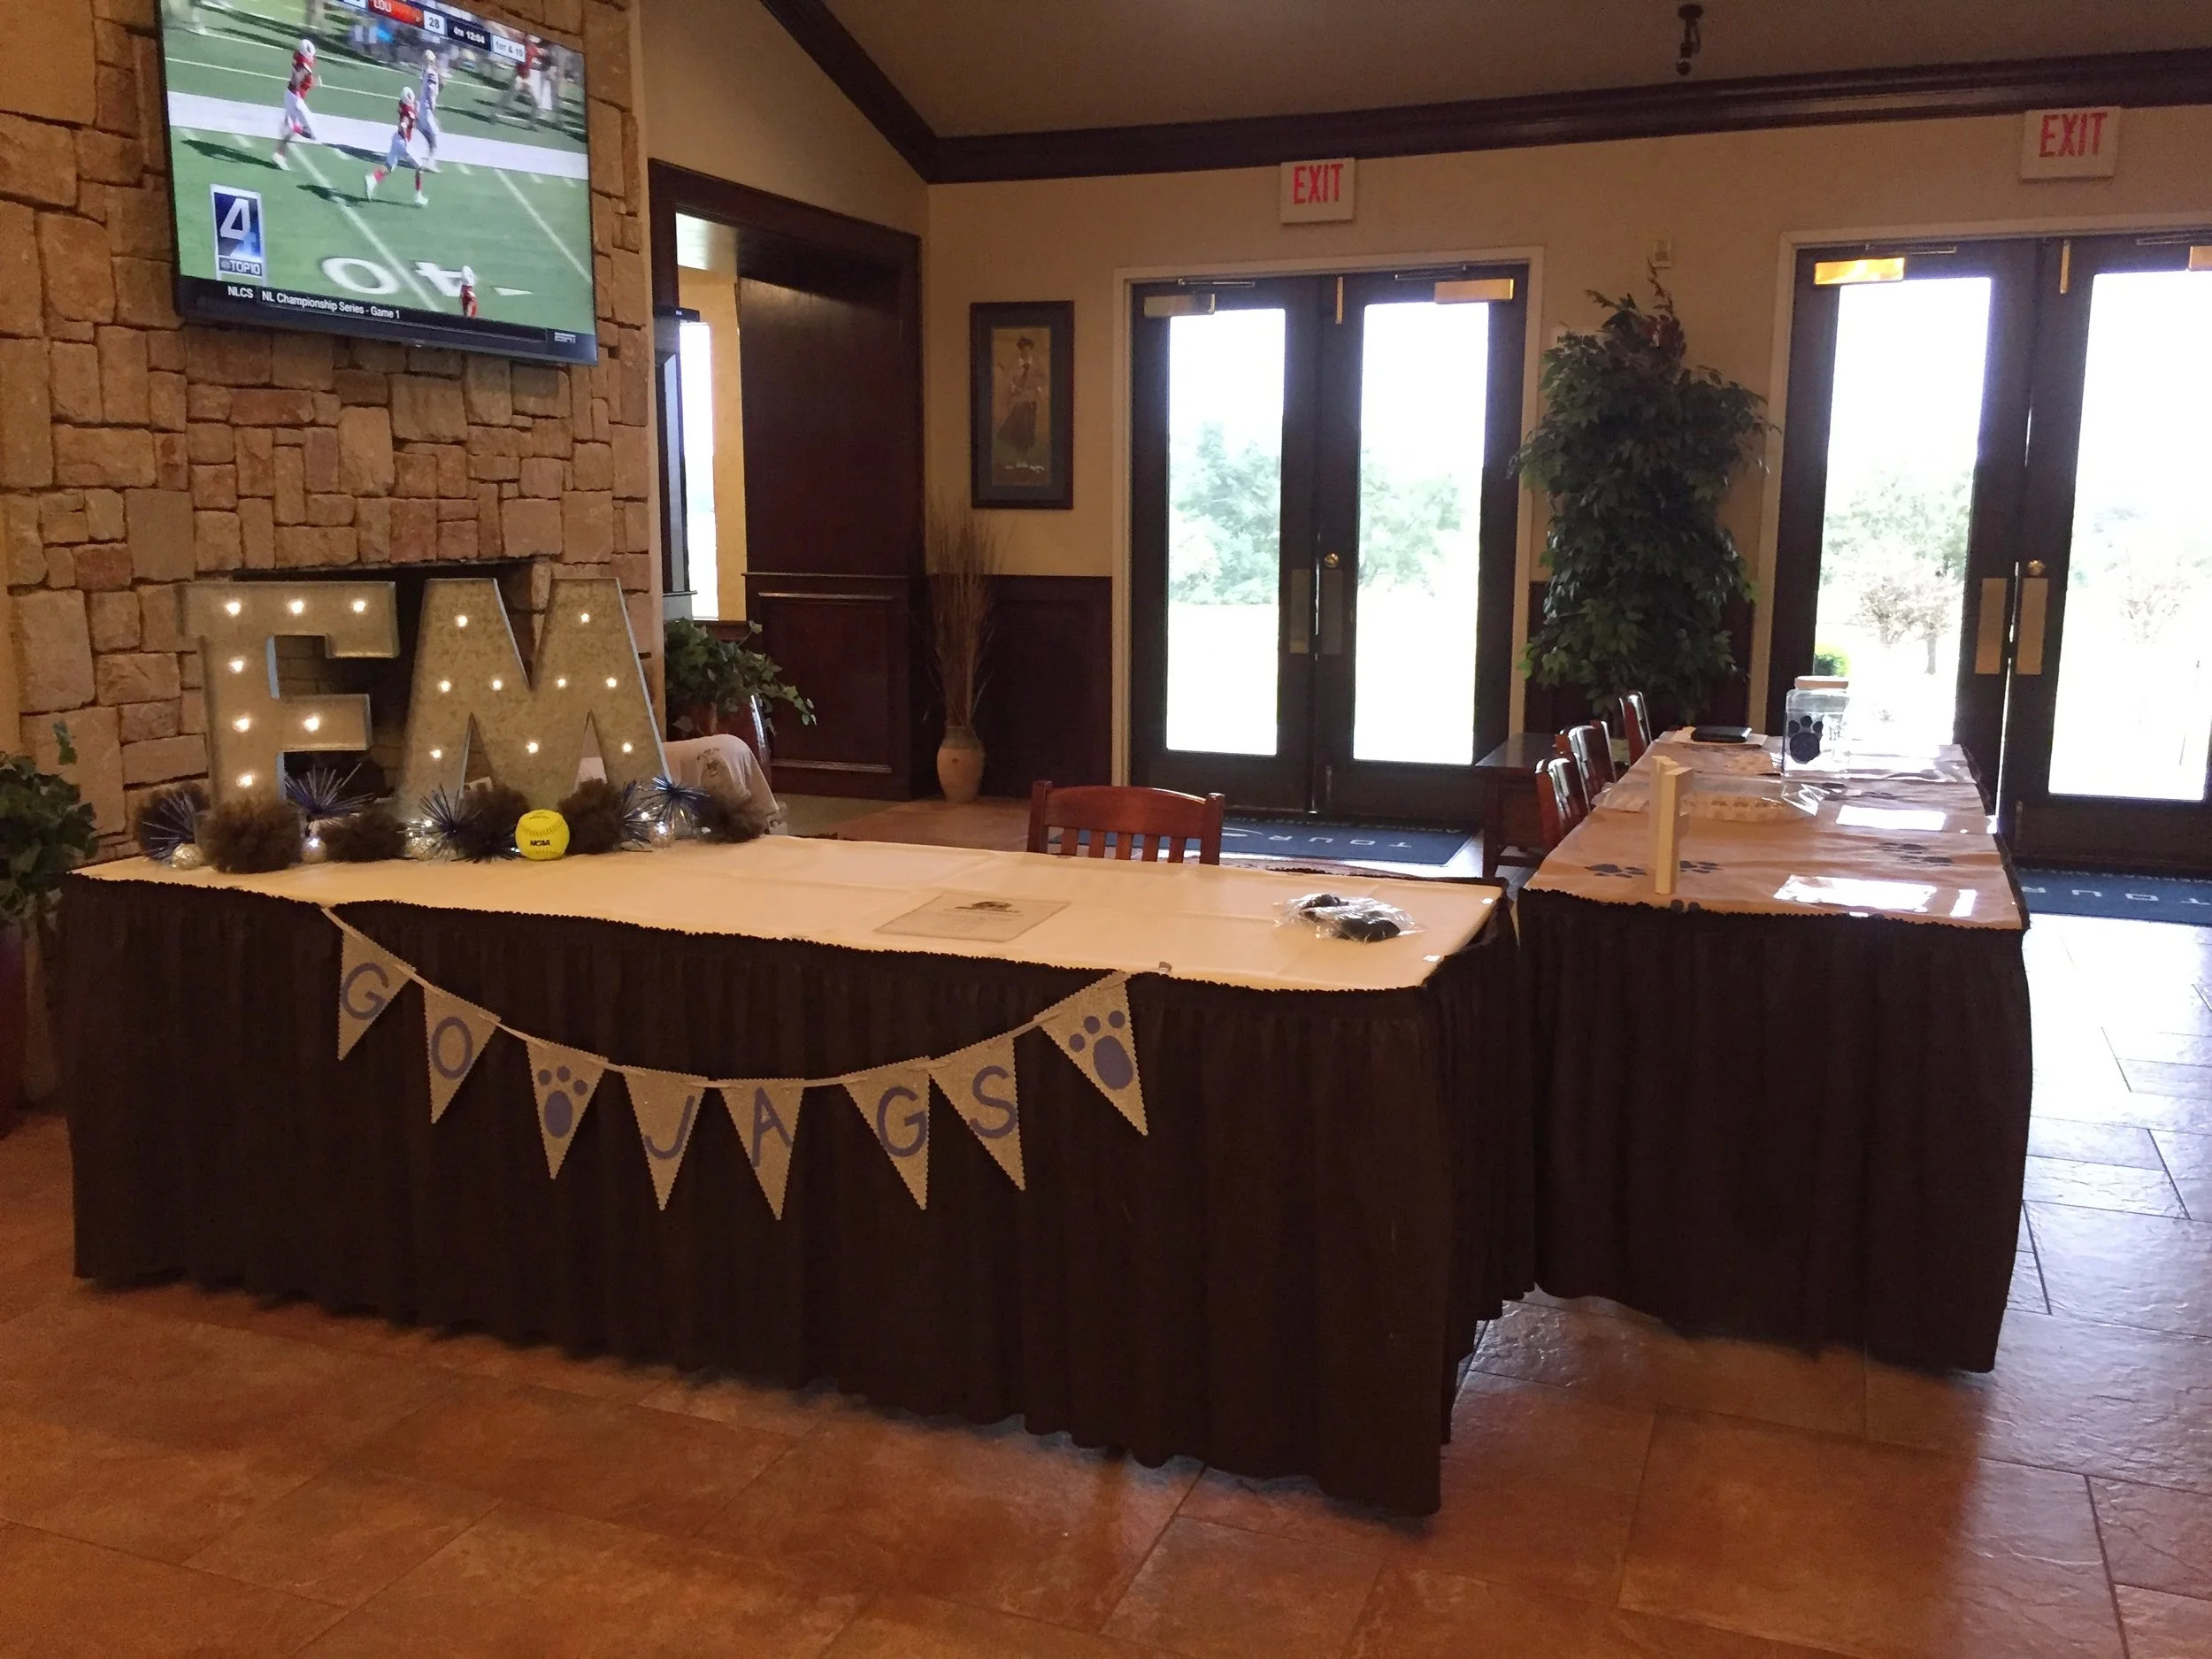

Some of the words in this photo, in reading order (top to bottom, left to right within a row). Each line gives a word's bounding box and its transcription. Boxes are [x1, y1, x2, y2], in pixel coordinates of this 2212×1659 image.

[428, 17, 440, 29] 28
[515, 48, 523, 57] 10
[2039, 111, 2108, 157] EXIT
[1293, 163, 1344, 204] EXIT
[219, 197, 257, 257] 4
[227, 285, 254, 299] NLCS
[261, 290, 275, 303] NL
[276, 292, 338, 312] Championship
[338, 300, 365, 314] Series
[370, 306, 395, 319] Game
[396, 310, 400, 319] 1
[643, 1064, 1018, 1168] JAGS
